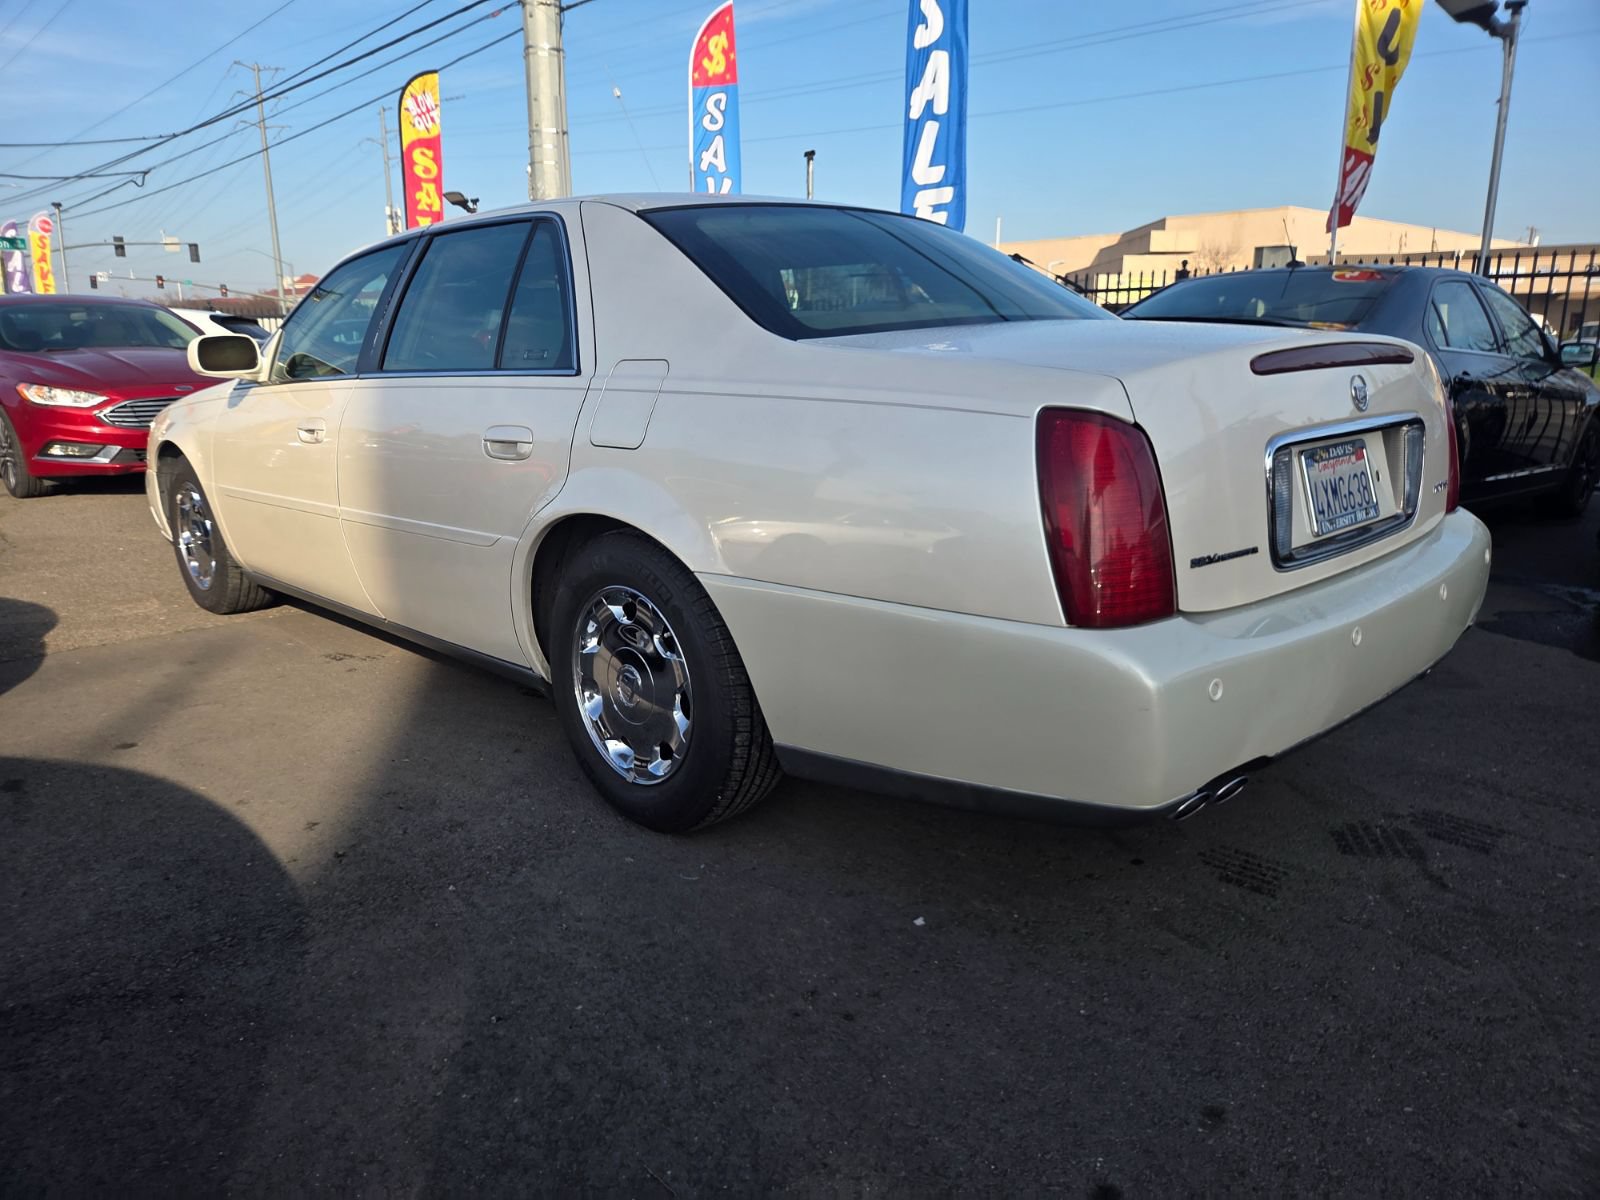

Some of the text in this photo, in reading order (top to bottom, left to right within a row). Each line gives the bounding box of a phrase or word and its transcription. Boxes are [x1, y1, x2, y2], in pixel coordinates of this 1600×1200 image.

[909, 0, 954, 225] SALE
[1329, 444, 1353, 457] DAVIS
[1314, 471, 1371, 518] 4XMG638
